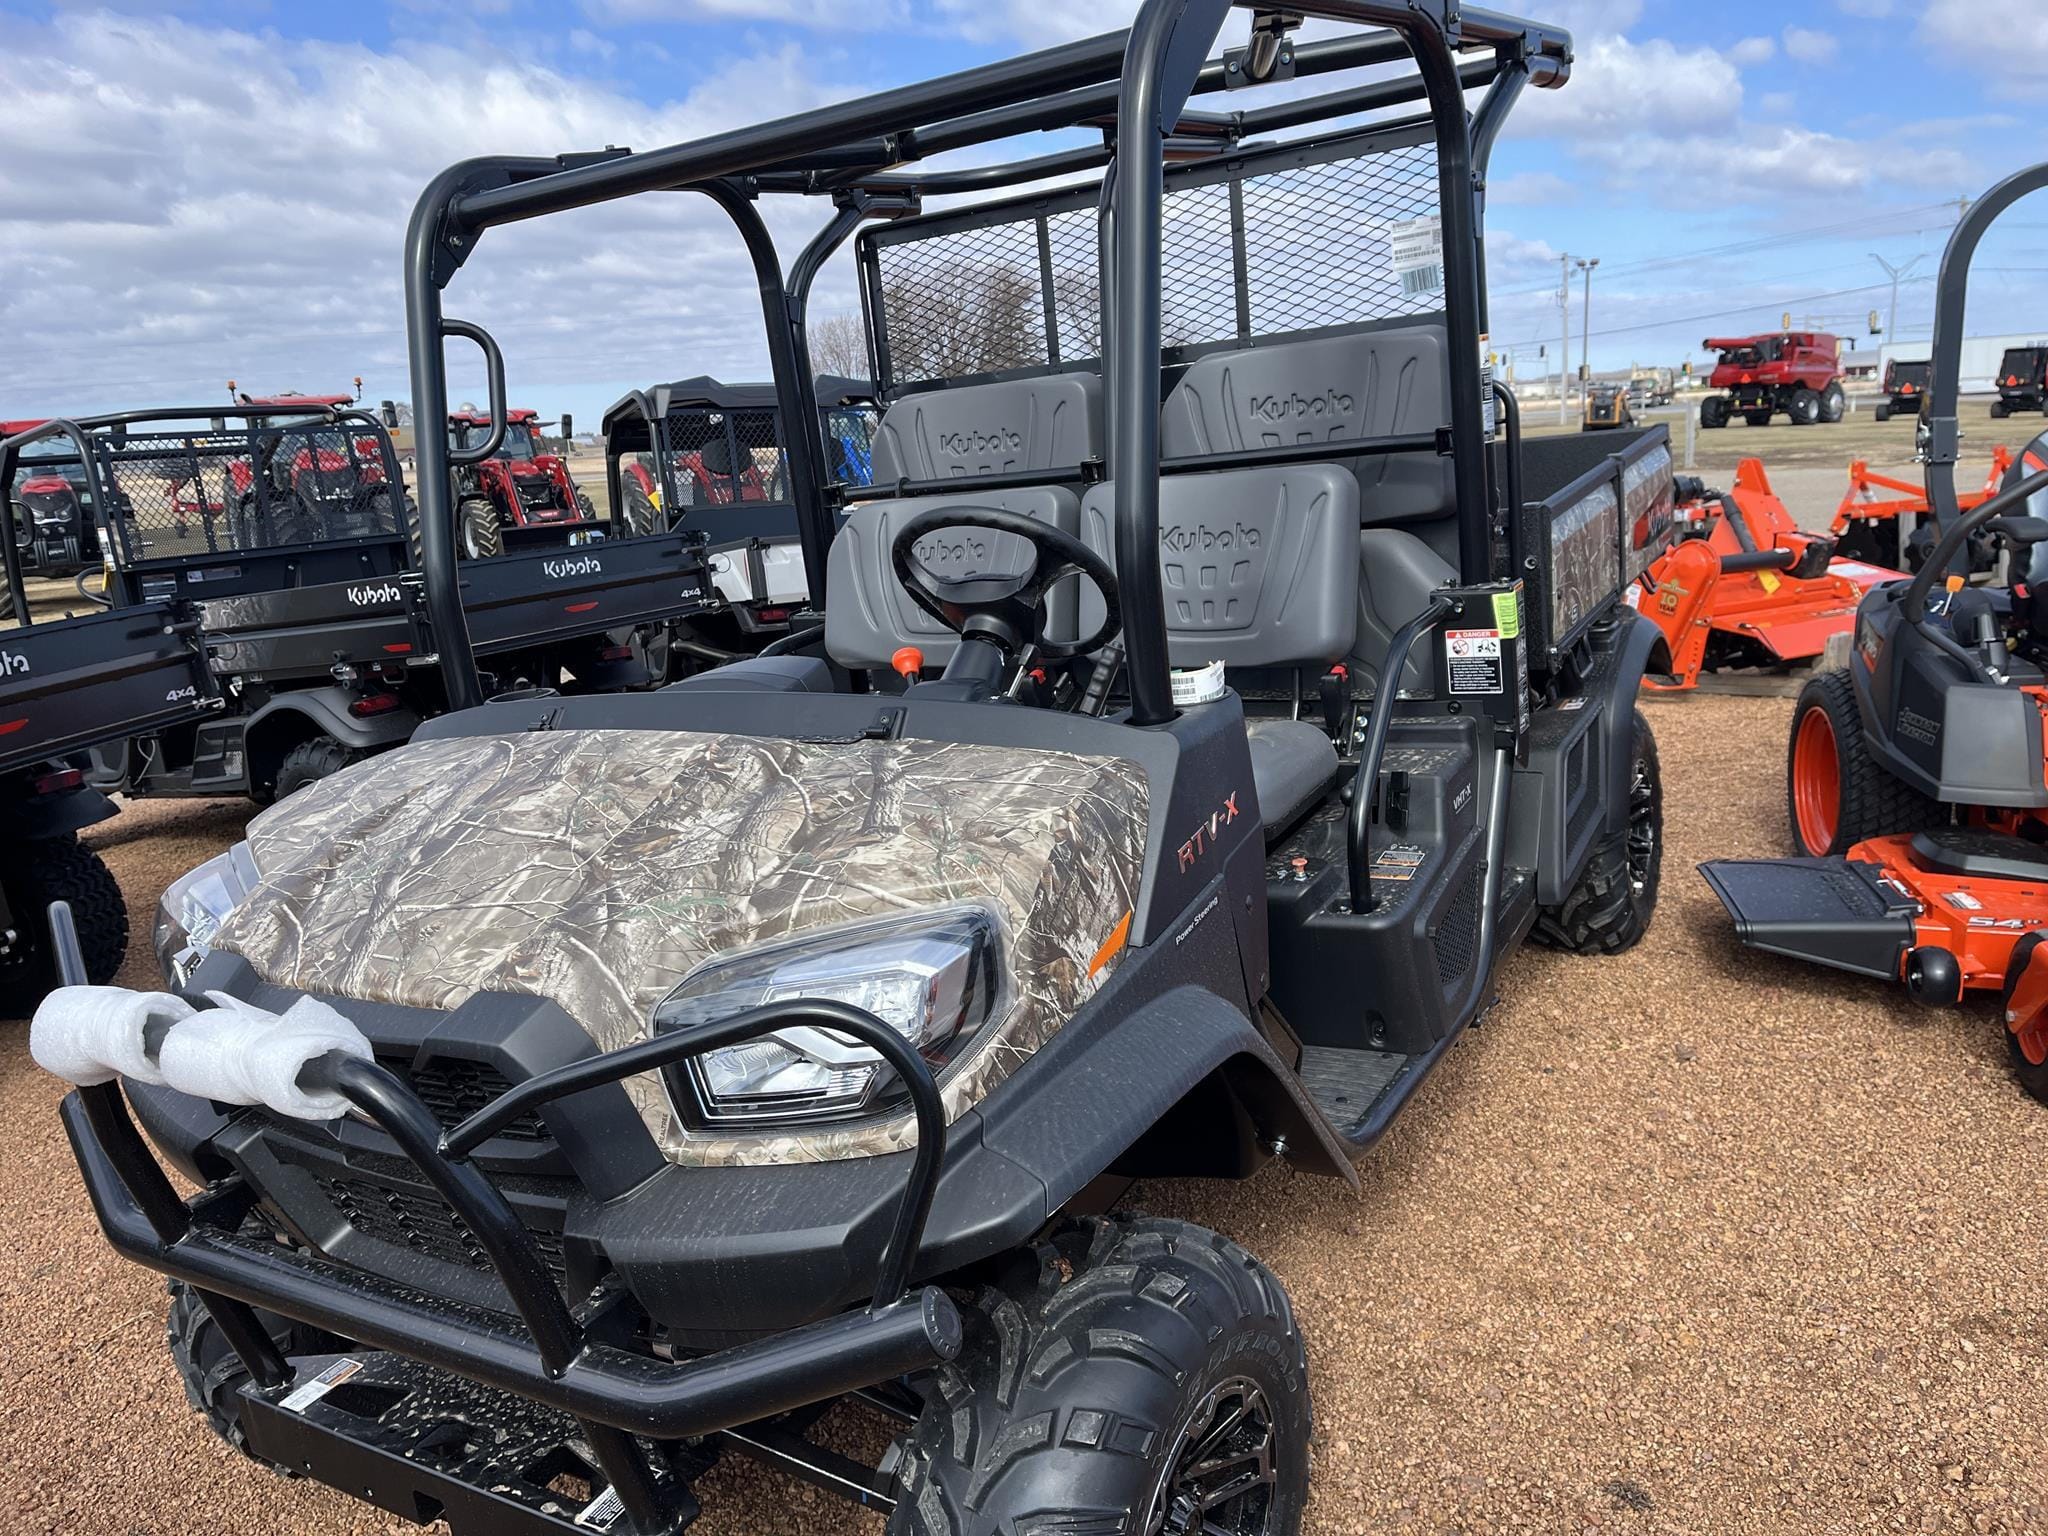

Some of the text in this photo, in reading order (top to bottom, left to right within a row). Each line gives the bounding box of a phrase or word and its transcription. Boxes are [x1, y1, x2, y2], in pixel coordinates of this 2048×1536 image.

[1250, 389, 1355, 424] Kubota
[939, 427, 1022, 457] Kubota
[1159, 523, 1261, 553] Kubota
[544, 557, 601, 578] Kubota
[347, 583, 401, 605] Kubota
[681, 588, 701, 598] 4x4
[1463, 630, 1490, 638] DANGER
[167, 686, 197, 701] 4x4
[1177, 790, 1239, 874] RTV-X
[1176, 896, 1218, 946] Power Steering
